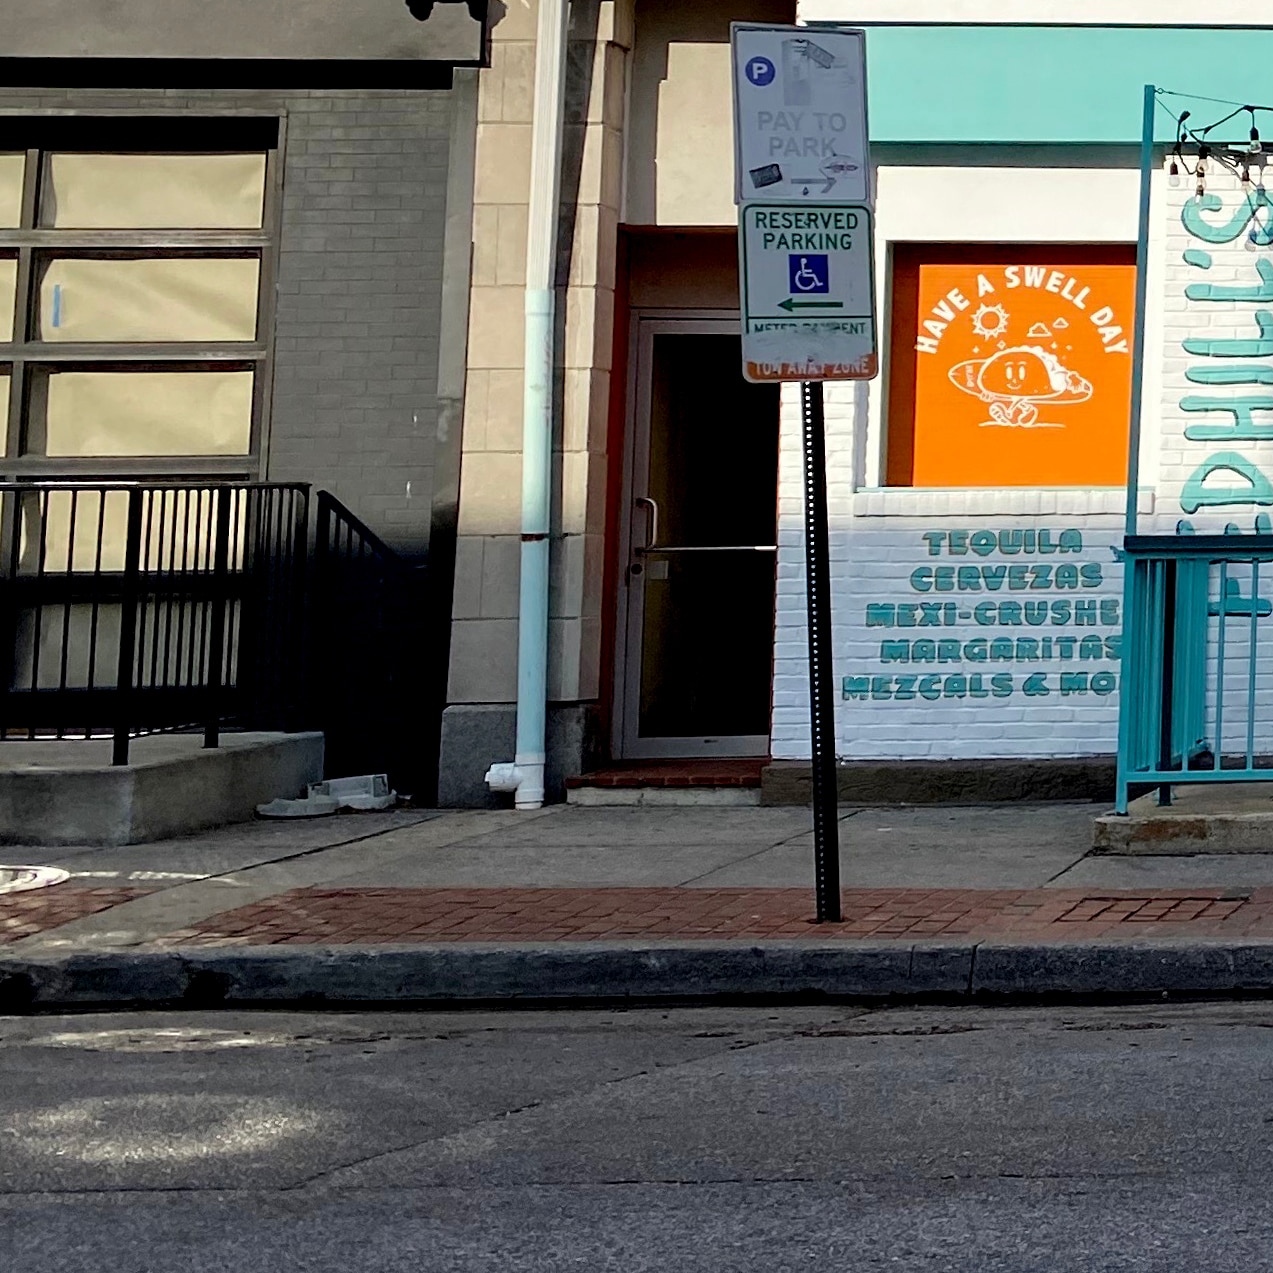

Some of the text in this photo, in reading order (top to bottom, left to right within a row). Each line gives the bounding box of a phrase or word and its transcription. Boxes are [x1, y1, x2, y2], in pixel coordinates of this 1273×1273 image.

[752, 62, 768, 80] P
[757, 111, 847, 132] PAY TO
[769, 136, 836, 157] PARK
[755, 212, 858, 229] RESERVED
[763, 233, 852, 250] PARKING
[916, 265, 1129, 354] HAVE A SWELL DAY
[921, 528, 1083, 556] TEQUILA
[910, 563, 1103, 592] CERVEZAS
[866, 599, 1120, 628] MEXI-CRUSHE
[880, 635, 1123, 664] MARGARITAS
[841, 671, 1118, 701] MEZCALS & MO
